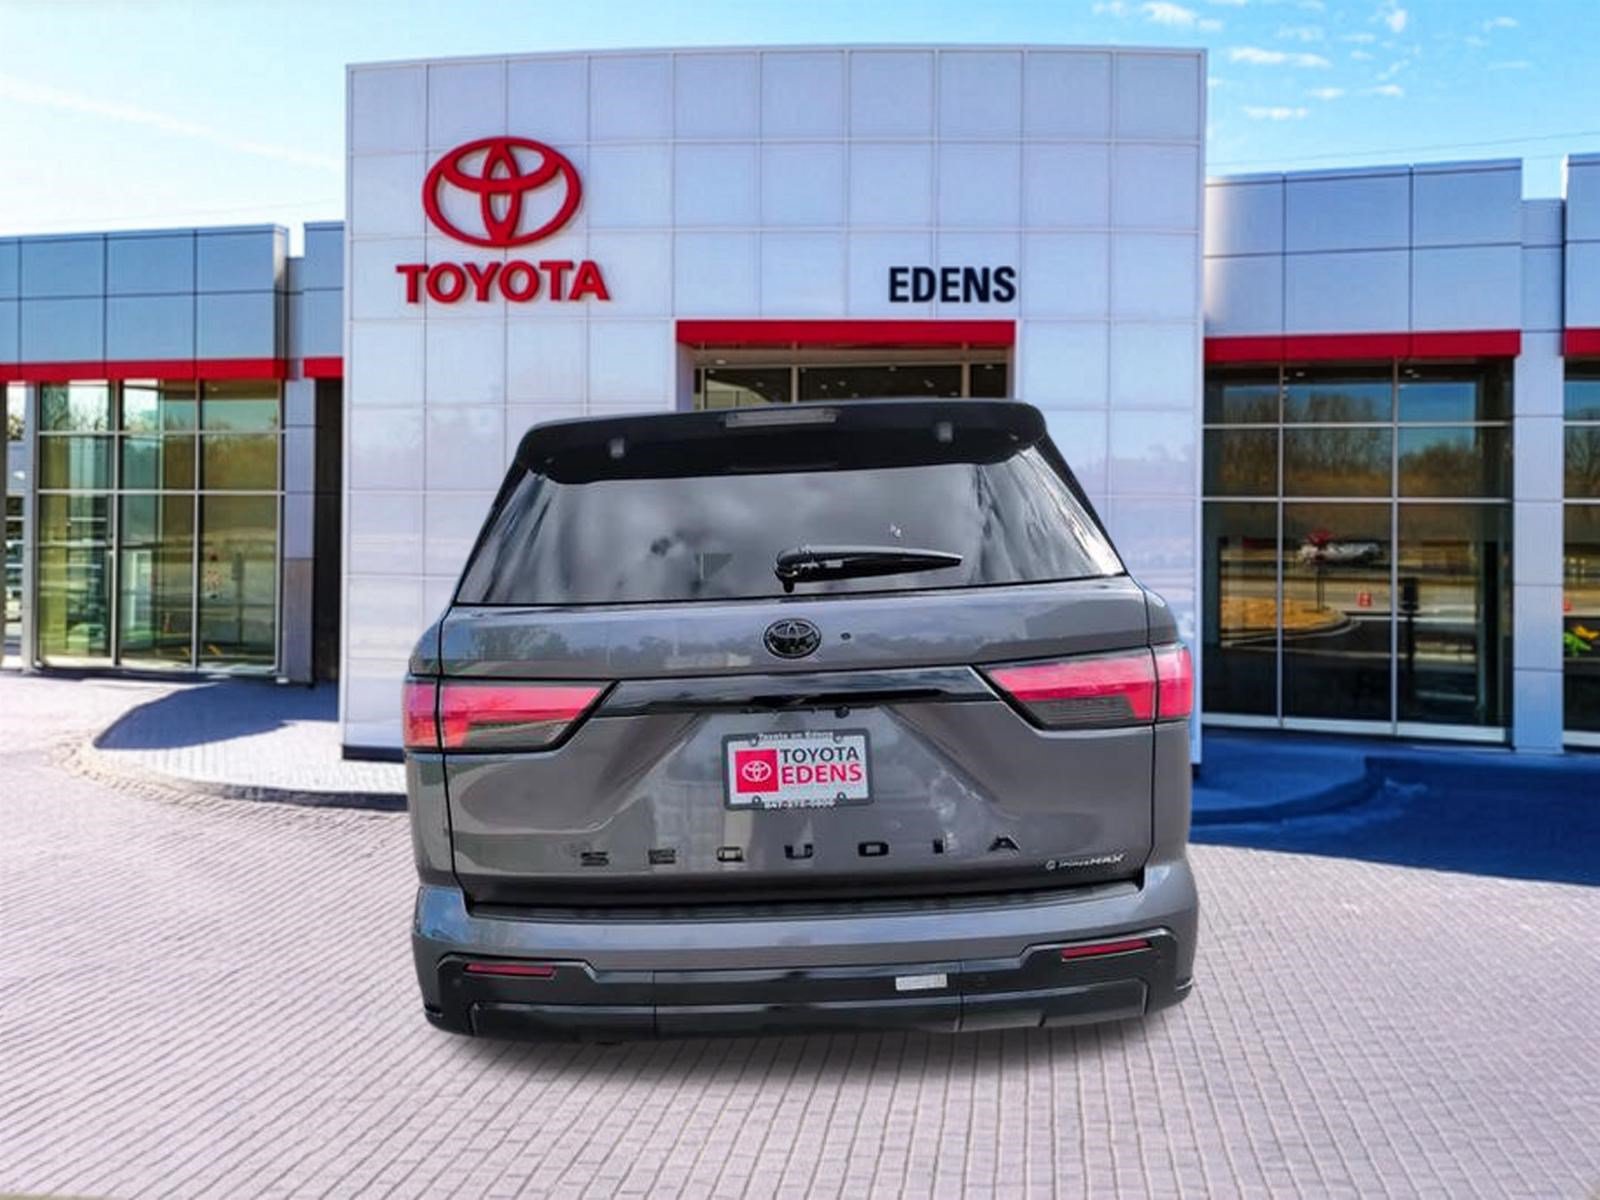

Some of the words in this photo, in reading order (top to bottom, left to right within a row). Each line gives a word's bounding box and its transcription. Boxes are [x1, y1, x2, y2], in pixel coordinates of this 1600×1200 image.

[396, 260, 610, 304] TOYOTA
[888, 266, 1017, 303] EDENS
[780, 747, 859, 763] TOYOTA
[781, 764, 862, 784] EDENS
[581, 837, 1020, 867] SEQUOIA
